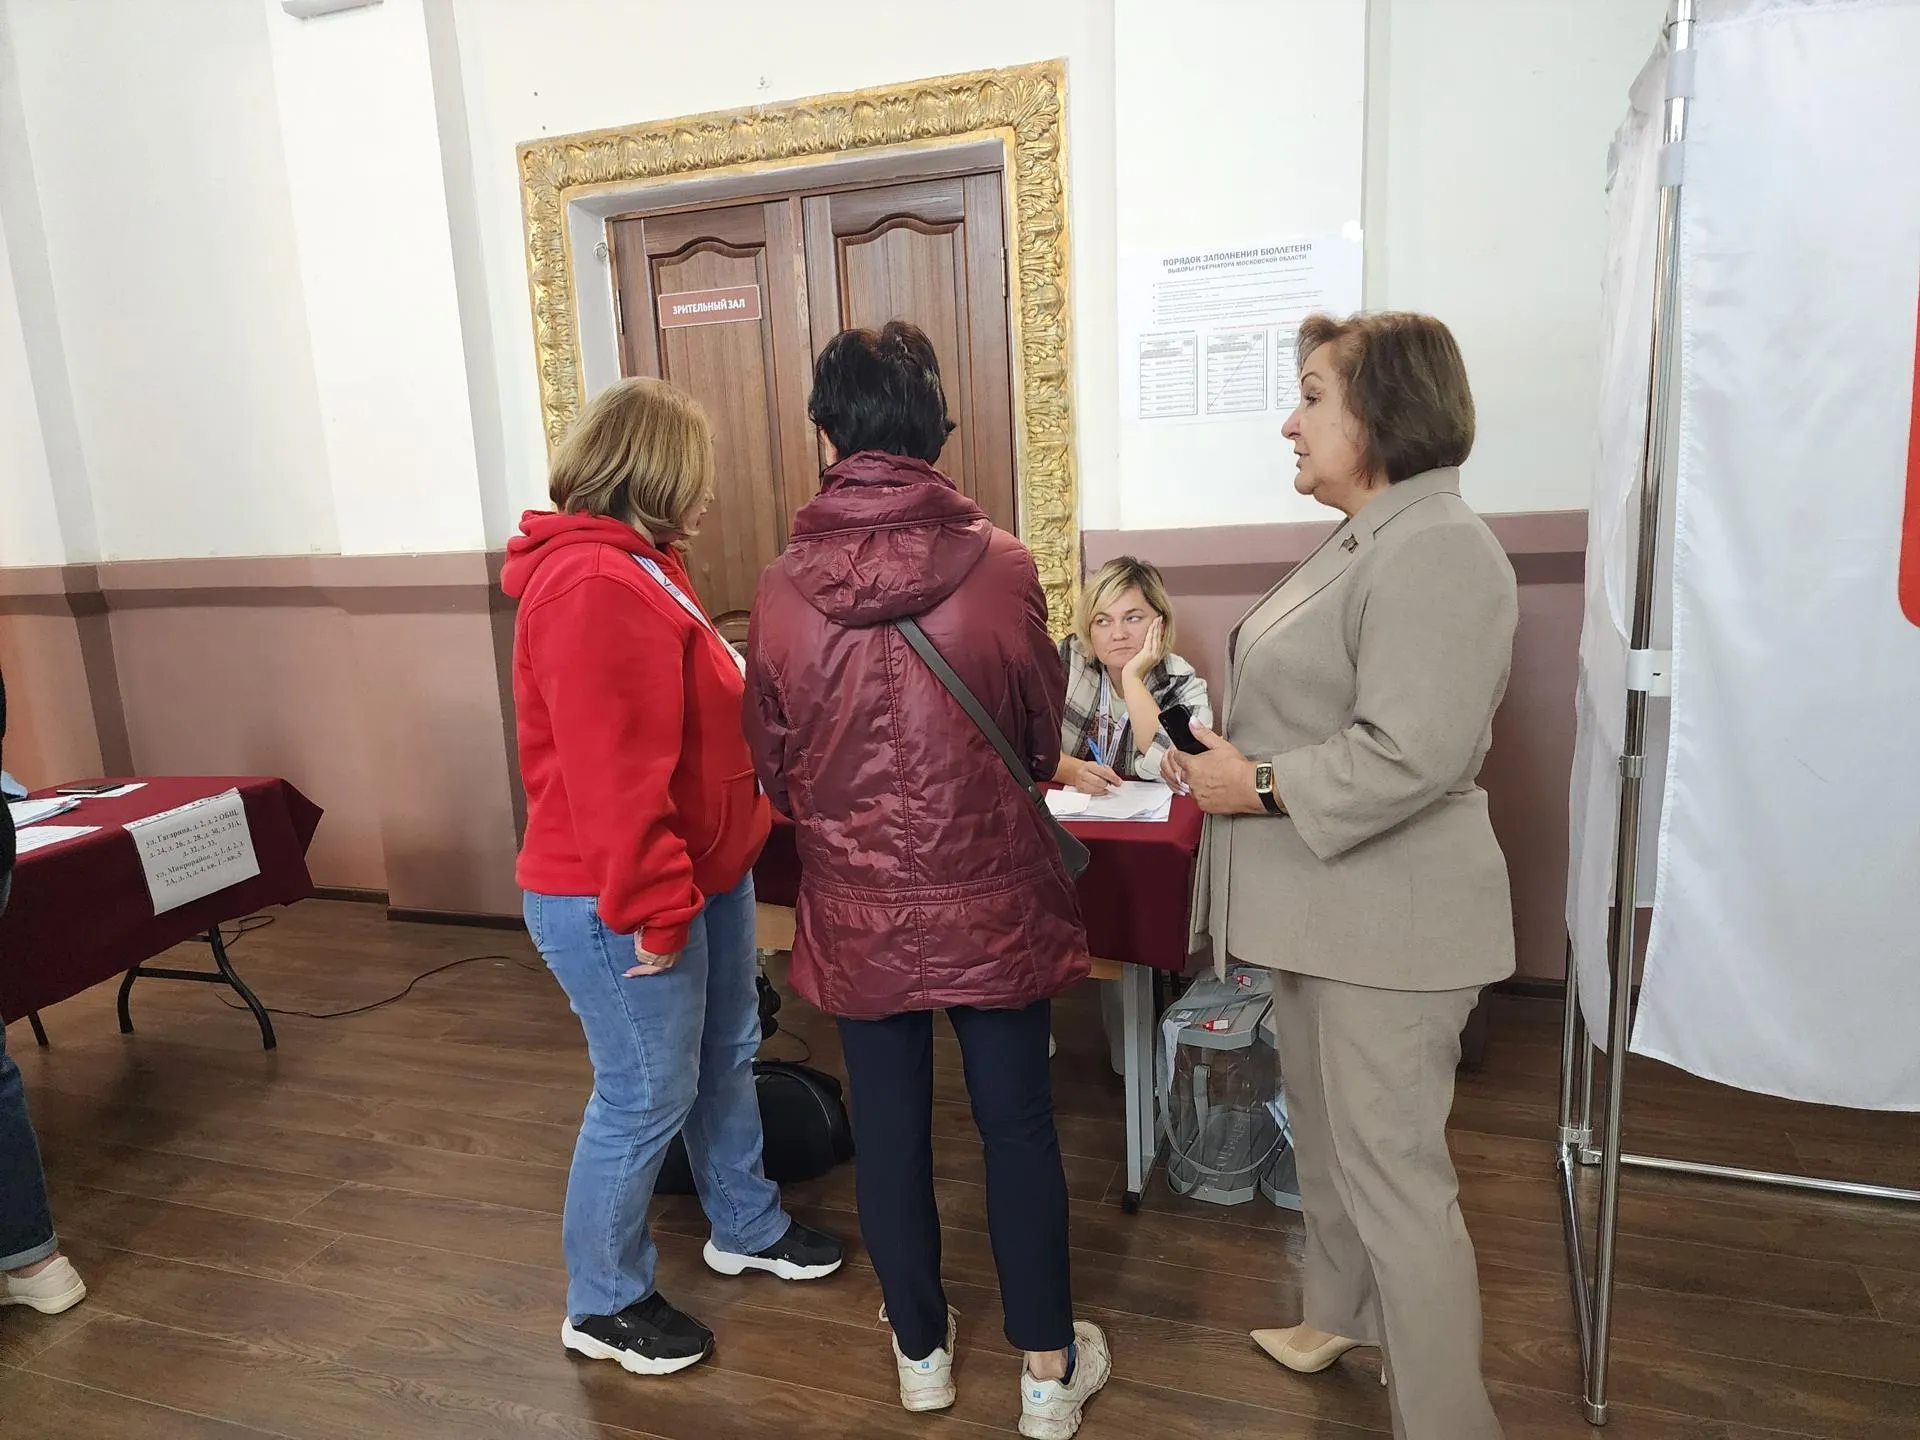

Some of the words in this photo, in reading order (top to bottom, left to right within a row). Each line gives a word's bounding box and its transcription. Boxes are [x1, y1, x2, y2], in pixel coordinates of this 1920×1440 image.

[1163, 255, 1201, 266] ПОРЯДОК
[1203, 249, 1258, 263] ЗАПОЛНЕНИЯ
[1260, 243, 1312, 256] БЮЛЛЕТЕНЯ
[1167, 265, 1195, 274] ВЫБОРЫ
[1195, 261, 1235, 271] ГУБЕРНАТОРА
[1235, 256, 1278, 267] МОСКОВСКОЙ
[1278, 253, 1307, 263] ОБЛАСТИ
[672, 298, 728, 315] ЗРИТЕЛЬНЫЙ
[728, 298, 746, 310] ЗАЛ
